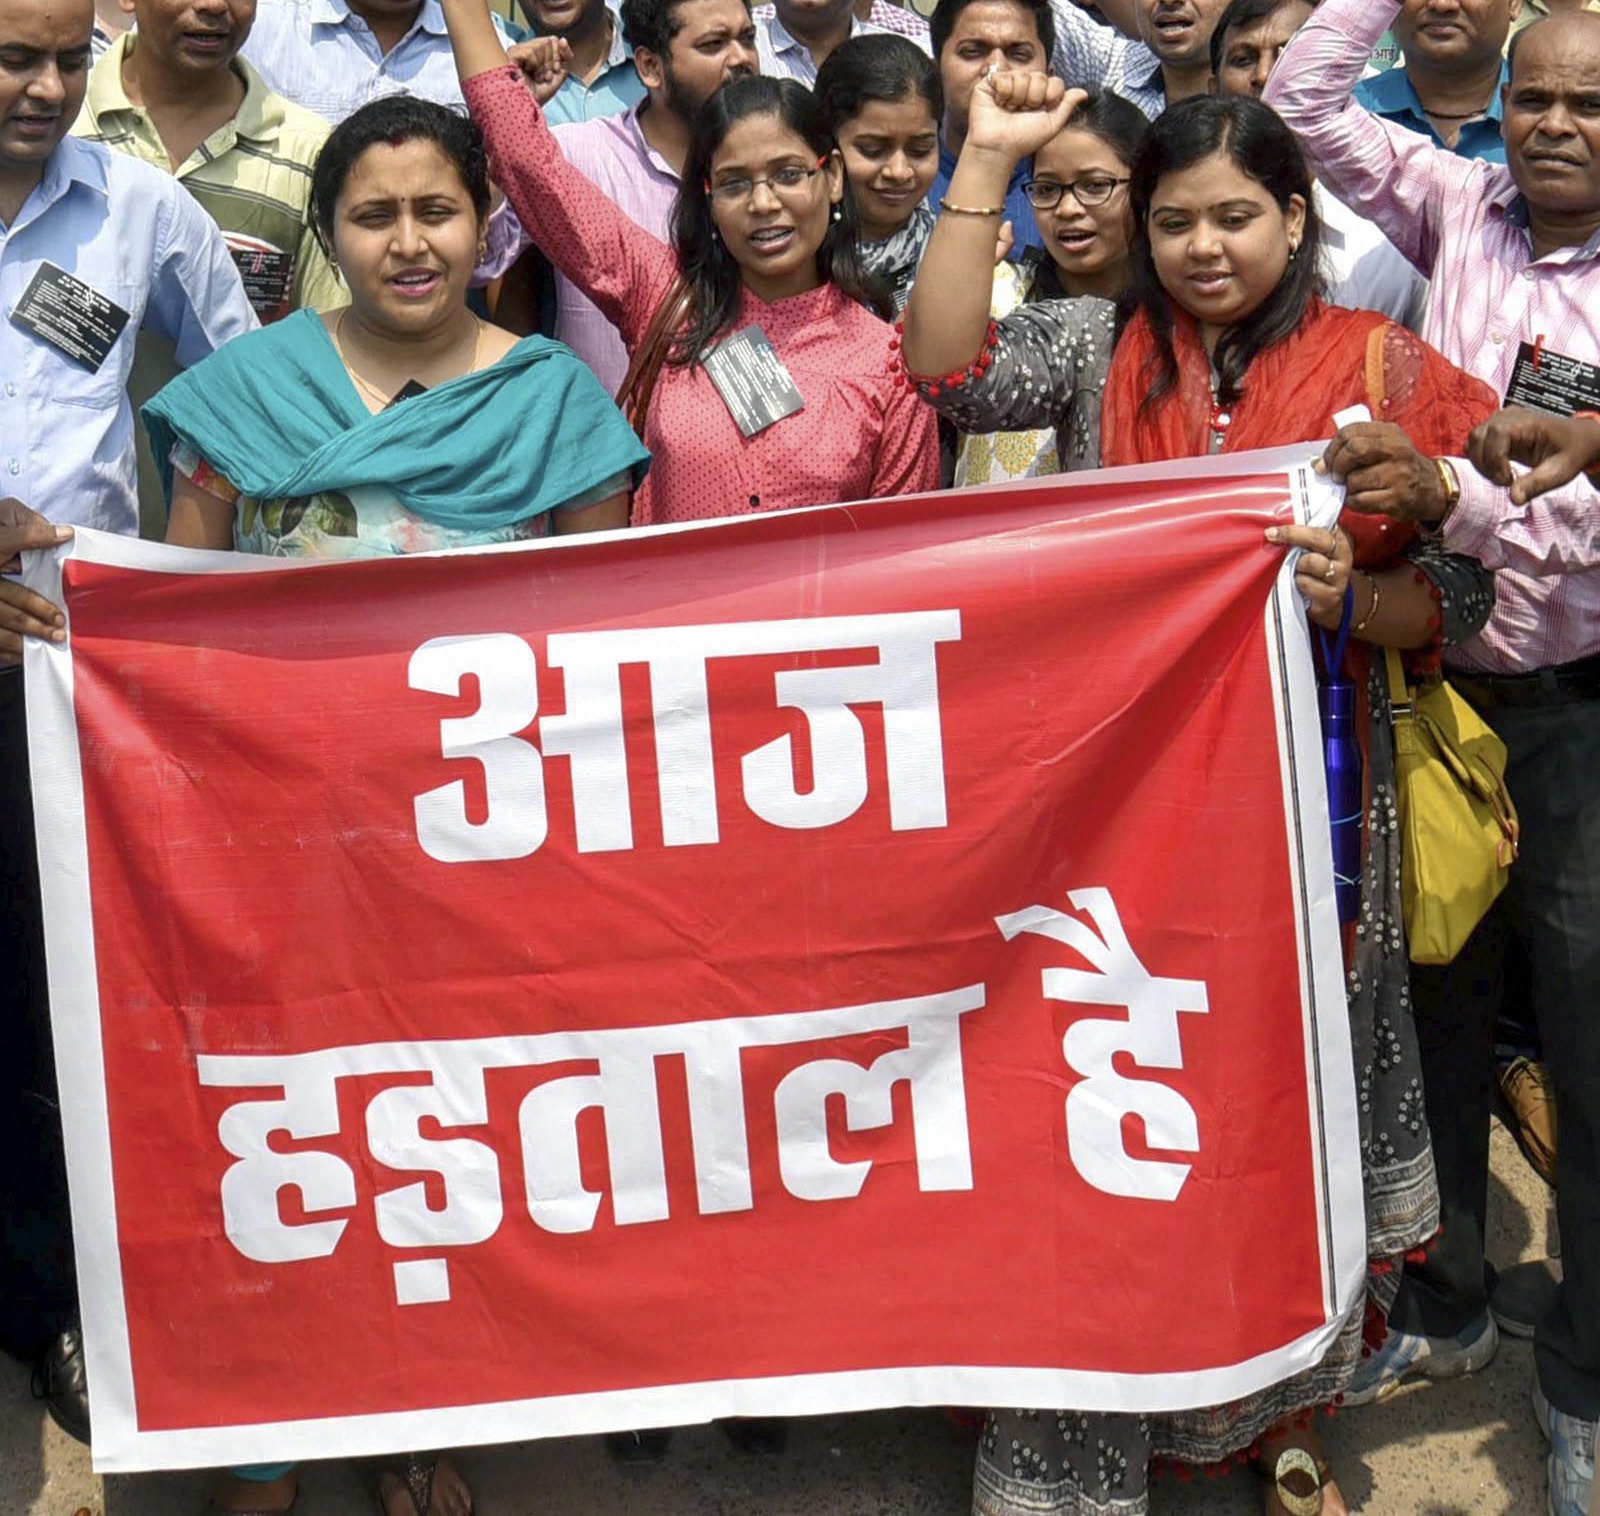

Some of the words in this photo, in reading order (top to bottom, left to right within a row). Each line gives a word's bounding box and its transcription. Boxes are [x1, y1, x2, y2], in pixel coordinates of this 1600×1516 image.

[407, 608, 963, 864] आज
[199, 983, 987, 1305] हड़ताल
[995, 887, 1209, 1203] है
